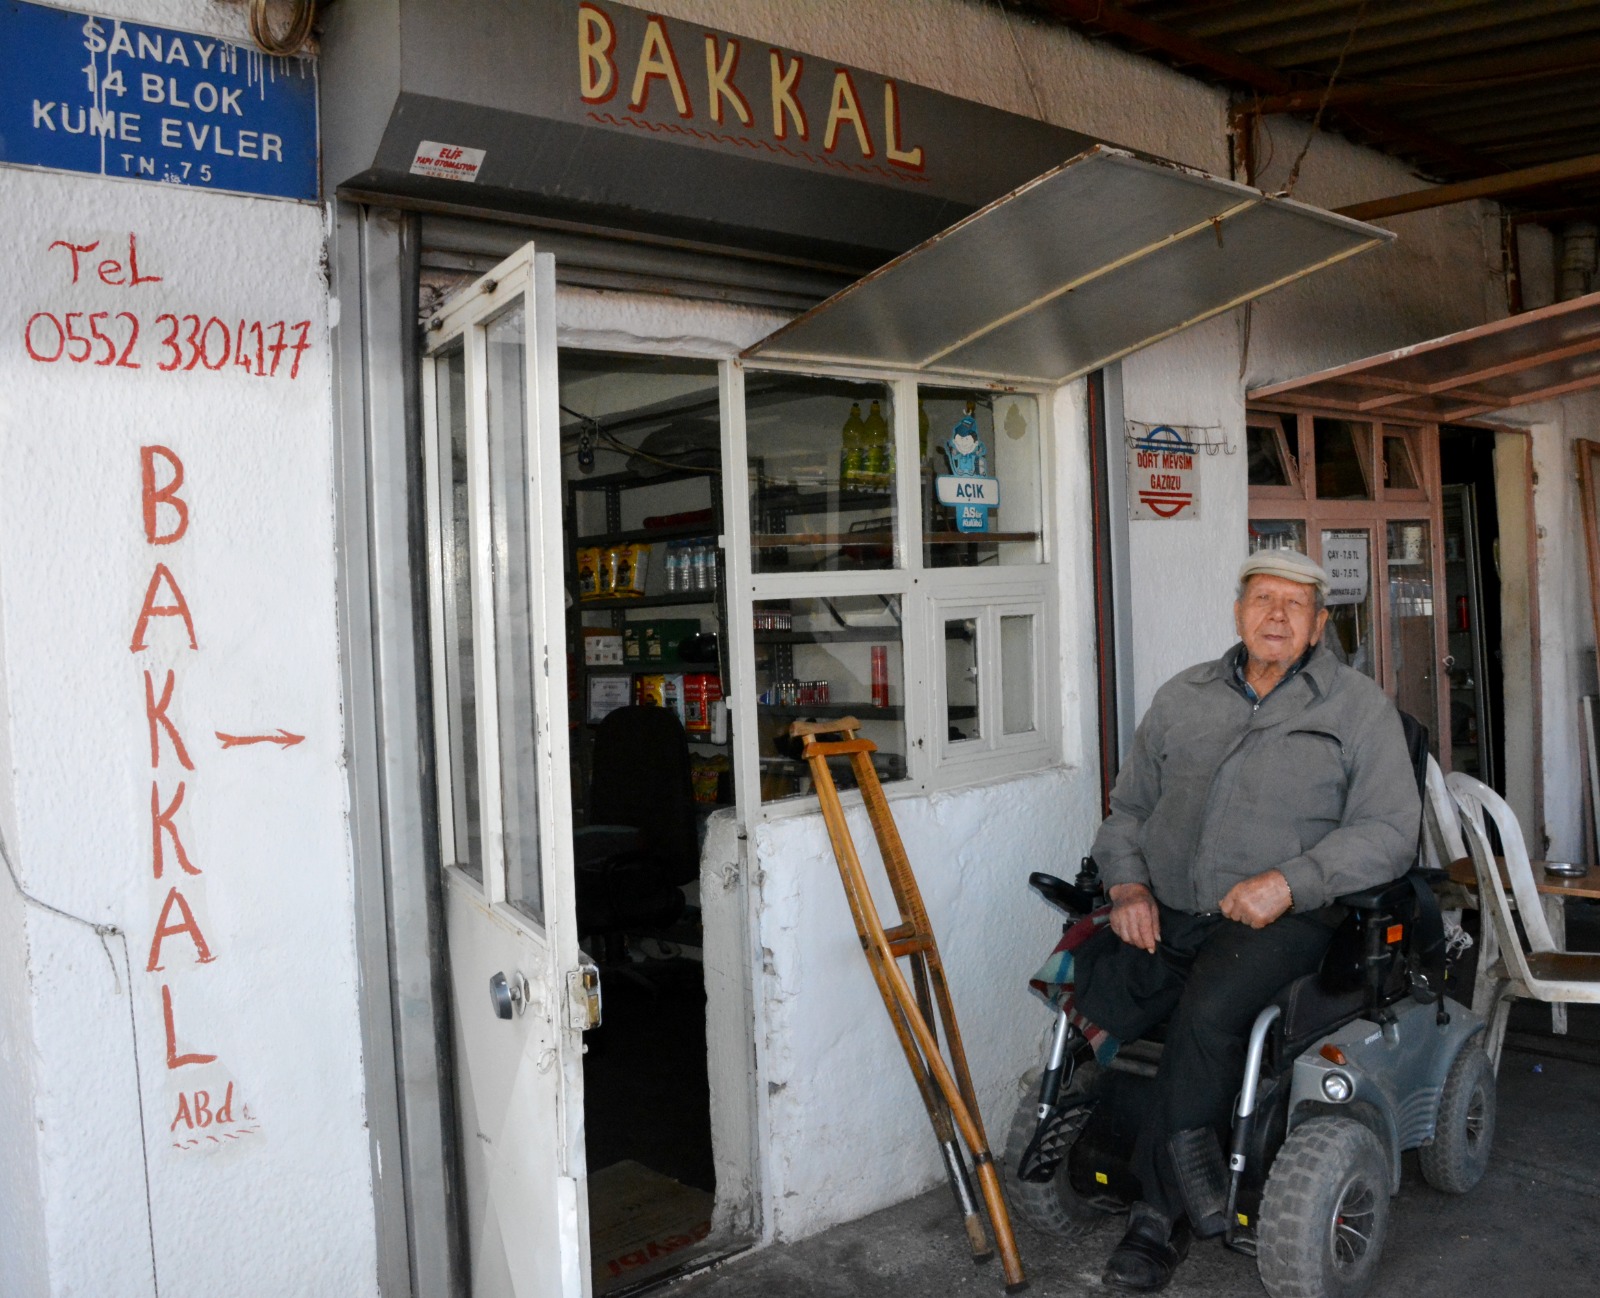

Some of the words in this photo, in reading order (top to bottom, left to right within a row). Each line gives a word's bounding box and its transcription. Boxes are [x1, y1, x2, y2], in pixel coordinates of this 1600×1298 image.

[82, 64, 127, 97] 14
[142, 72, 243, 117] BLOK
[578, 2, 925, 173] BAKKAL
[33, 99, 141, 143] KÜME
[161, 117, 283, 162] EVLER
[439, 147, 463, 159] ELİF
[416, 157, 434, 165] YAPI
[434, 159, 478, 172] OTOMASYON
[25, 311, 141, 369] 0552
[1137, 450, 1158, 469] DÖRT
[1150, 474, 1181, 490] GAZOZU
[956, 483, 985, 502] AÇIK
[1327, 550, 1339, 561] ÇAY
[1353, 550, 1360, 560] TL
[1331, 568, 1340, 578] SU
[1353, 568, 1360, 578] TL
[130, 444, 218, 1070] BAKKAL
